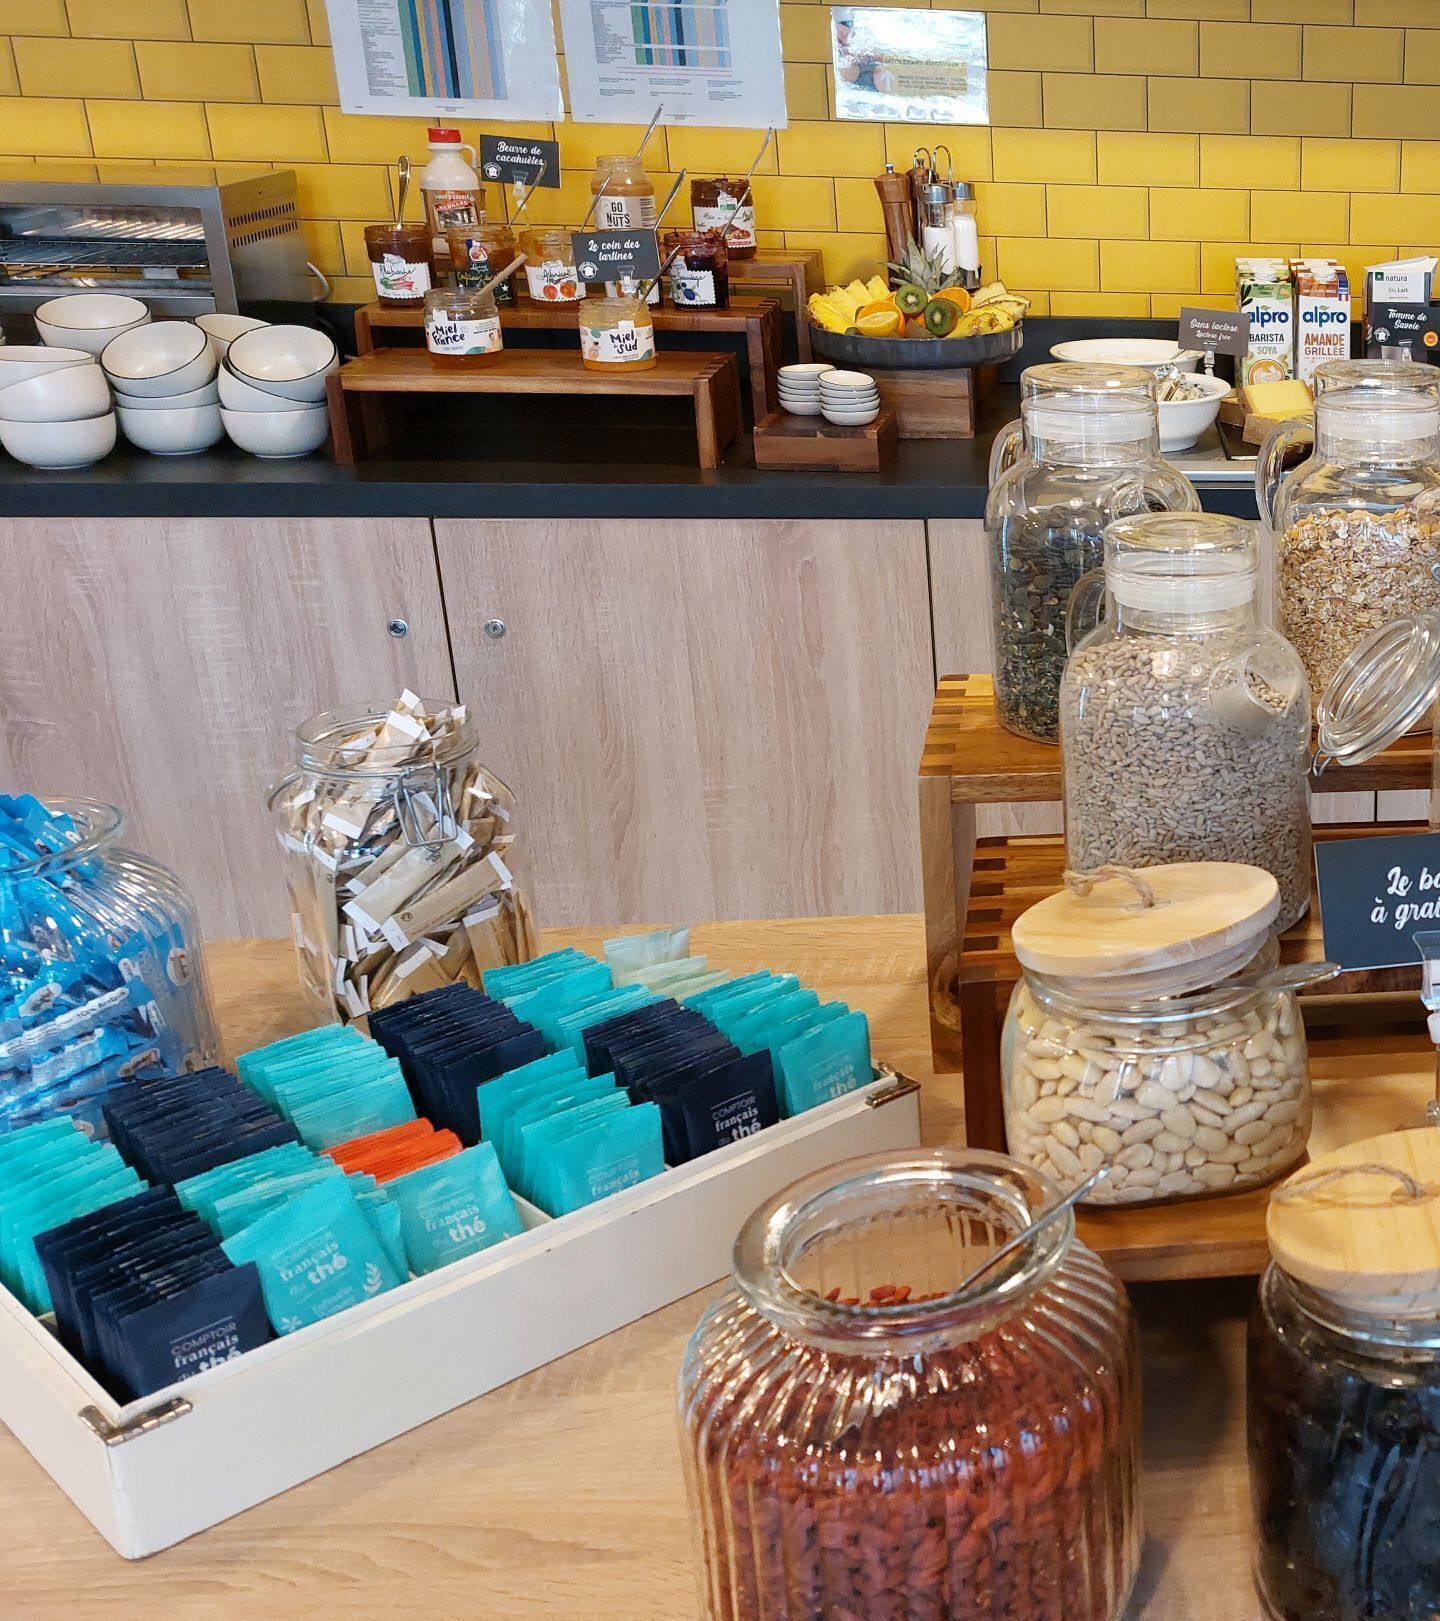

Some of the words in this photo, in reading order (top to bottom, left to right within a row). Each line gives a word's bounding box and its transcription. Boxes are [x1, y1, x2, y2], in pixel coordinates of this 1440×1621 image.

[497, 141, 529, 154] Beurre
[530, 145, 542, 156] de
[495, 154, 545, 166] cacahuètes
[611, 202, 623, 213] GO
[606, 212, 630, 227] NUTS
[588, 239, 600, 252] Le
[601, 240, 622, 251] coin
[623, 239, 640, 249] des
[598, 251, 634, 262] tartines
[1385, 274, 1408, 282] natura
[1302, 305, 1348, 328] alpro
[1387, 308, 1416, 320] Tomme
[1416, 312, 1428, 321] de
[434, 322, 457, 336] Miel
[1190, 318, 1210, 329] Sans
[1211, 321, 1239, 333] lactose
[1394, 319, 1420, 331] Savoie
[431, 331, 465, 346] France
[609, 329, 635, 344] Miel
[1218, 332, 1232, 341] free
[1249, 333, 1285, 343] BARISTA
[1304, 333, 1345, 346] AMANDE
[1256, 346, 1278, 355] SOYA
[1304, 345, 1345, 356] GRILLÉE
[1387, 866, 1413, 897] Le
[1370, 896, 1389, 924] à
[712, 1095, 756, 1121] COMPTOIR
[715, 1106, 759, 1133] français
[731, 1117, 762, 1140] thé
[425, 1204, 480, 1233] français
[448, 1214, 486, 1243] thé
[307, 1252, 348, 1285] thé
[171, 1322, 237, 1356] COMPTOIR
[174, 1334, 239, 1369] français
